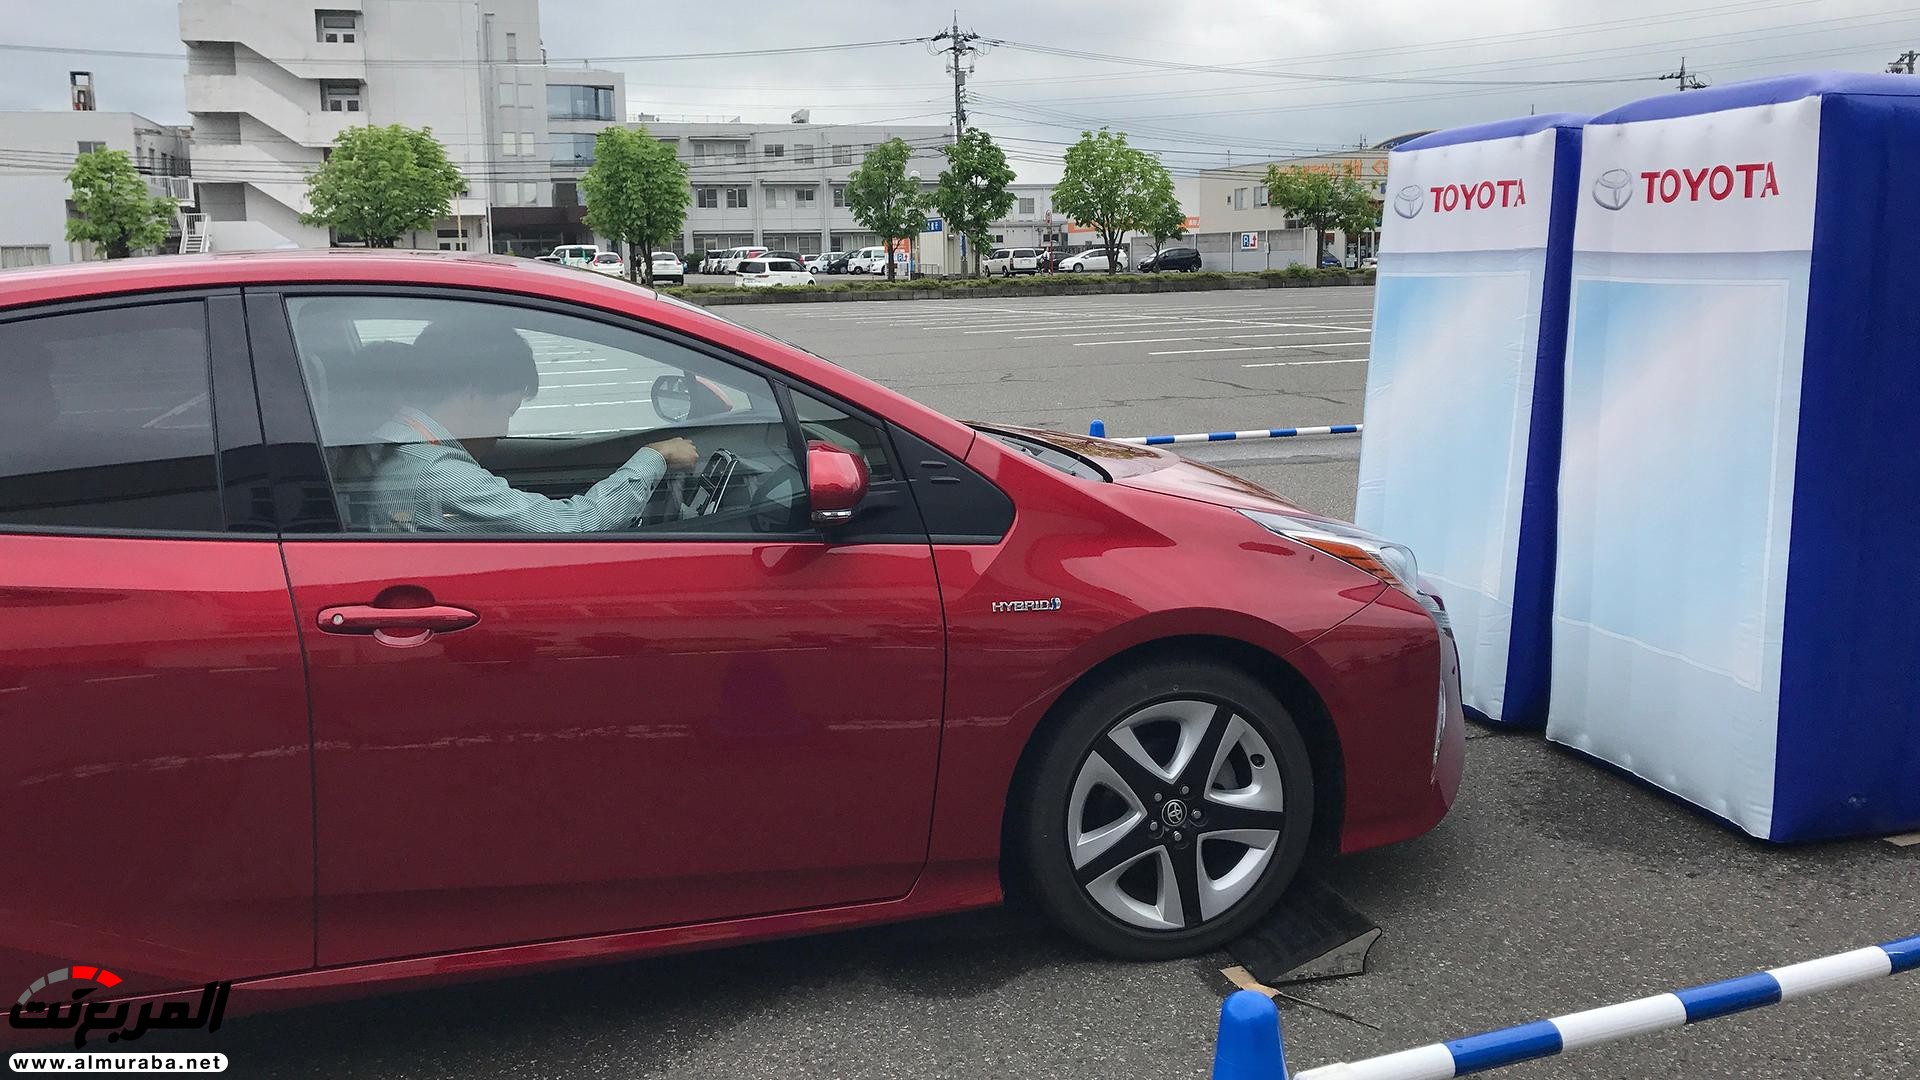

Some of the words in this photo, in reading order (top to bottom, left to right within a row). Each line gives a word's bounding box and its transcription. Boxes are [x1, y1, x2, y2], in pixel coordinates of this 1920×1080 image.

[1430, 178, 1526, 213] TOYOTA
[1640, 161, 1780, 204] TOYOTA
[991, 599, 1050, 613] HYBRID
